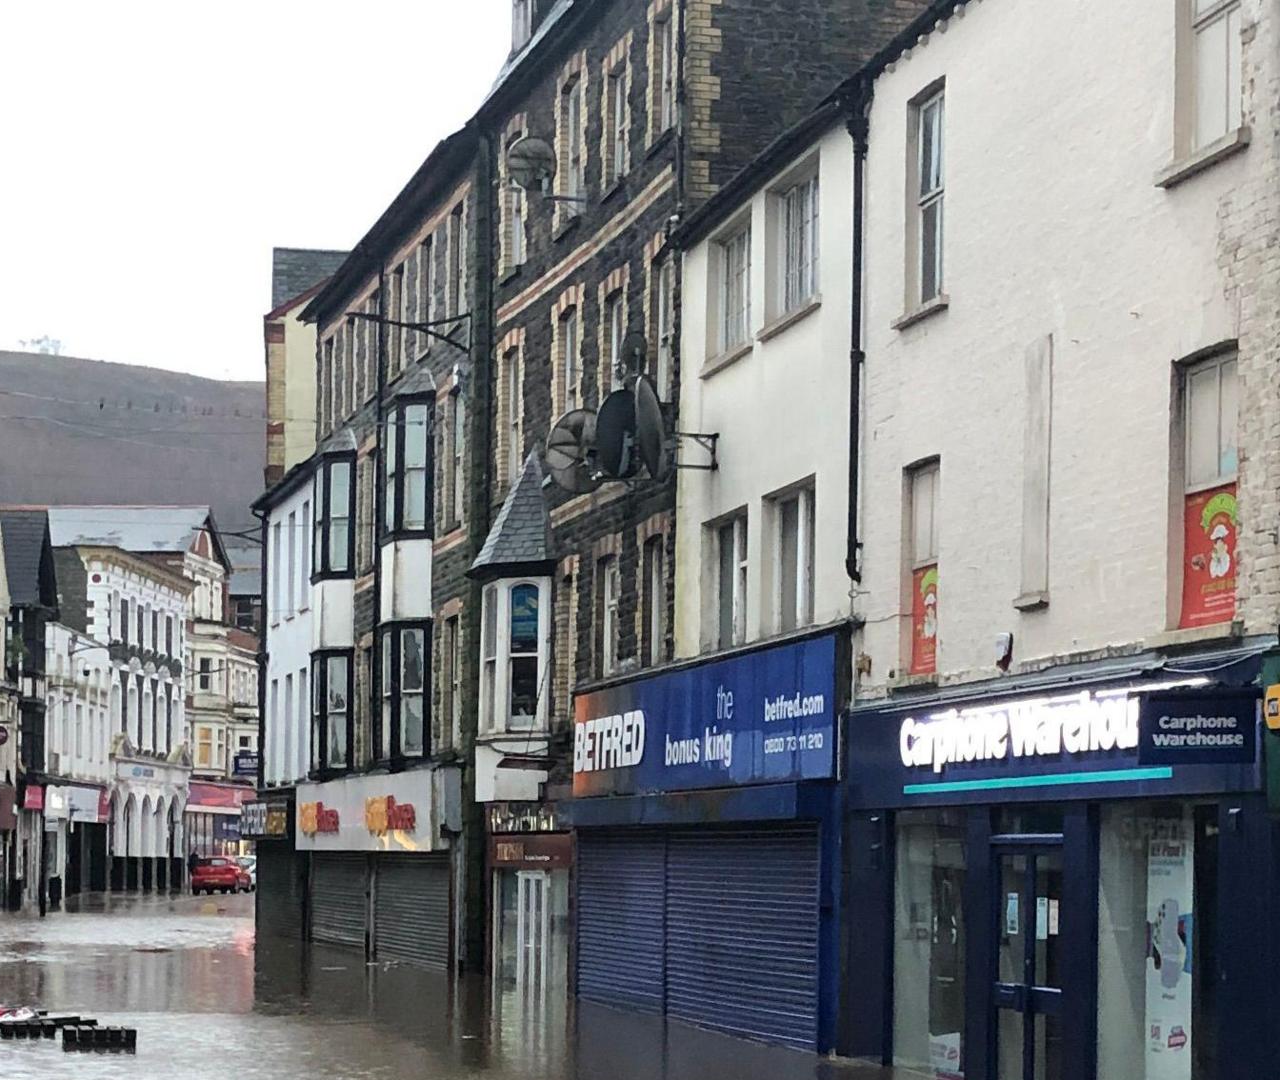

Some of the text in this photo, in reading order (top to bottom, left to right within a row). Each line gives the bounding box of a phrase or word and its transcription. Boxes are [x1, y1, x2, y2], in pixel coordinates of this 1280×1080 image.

[716, 684, 734, 721] the
[764, 692, 824, 723] betfred.com
[899, 690, 1140, 774] Carphone Warehou
[1159, 714, 1237, 731] Carphone
[573, 709, 646, 773] BETFRED
[665, 725, 733, 768] bonus king
[764, 732, 824, 755] 0800 73 11 210
[1152, 731, 1244, 749] Warehouse
